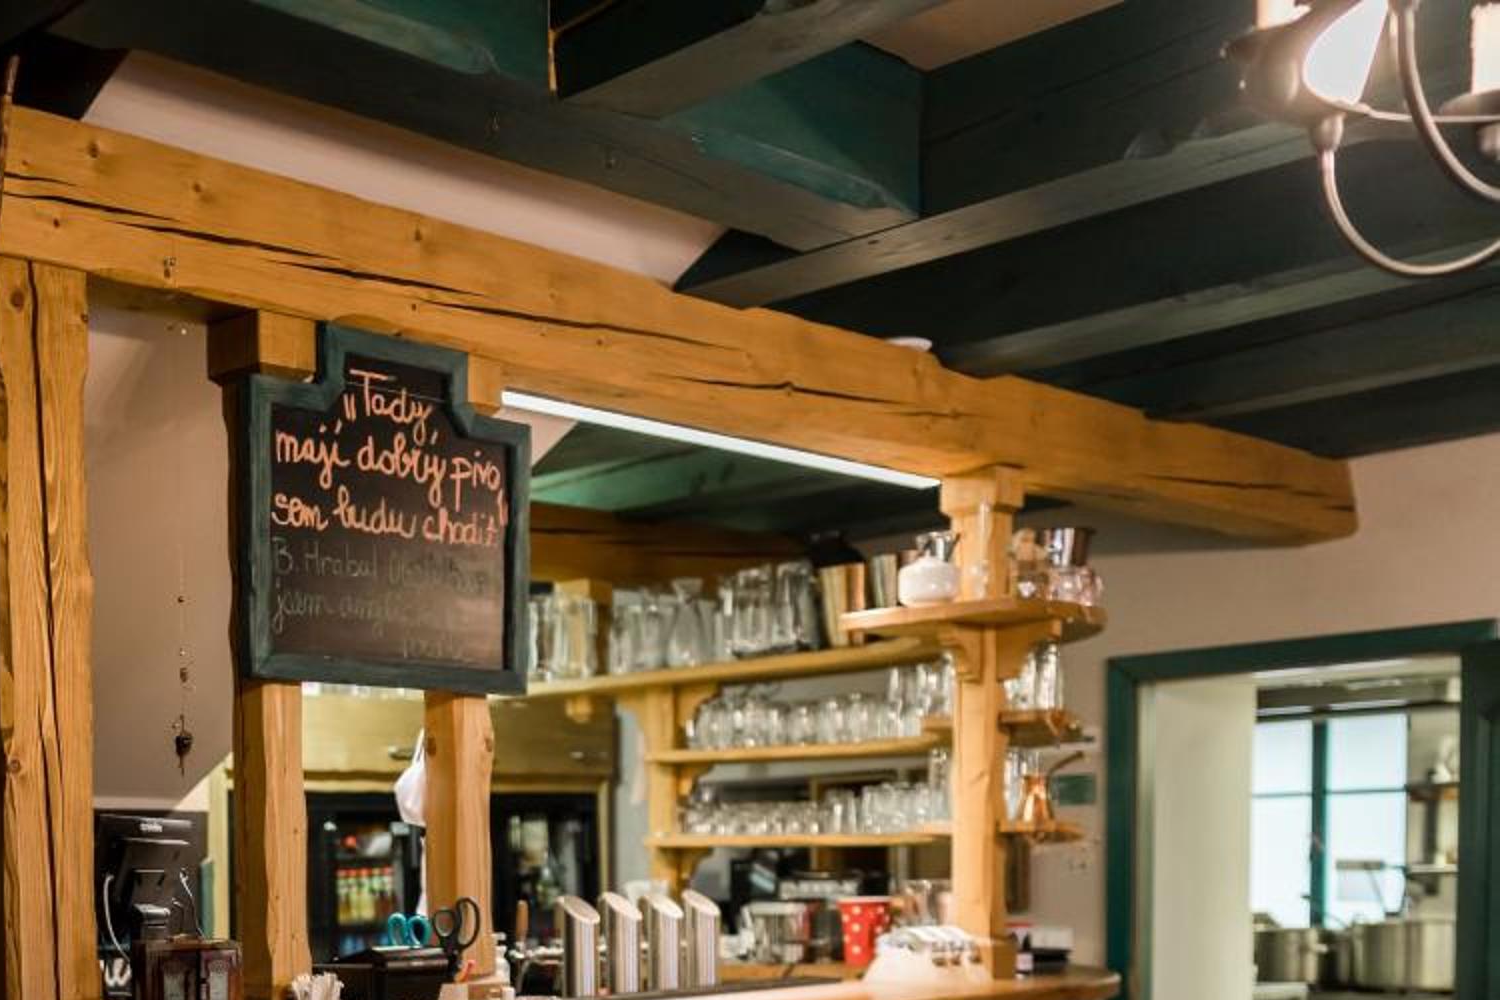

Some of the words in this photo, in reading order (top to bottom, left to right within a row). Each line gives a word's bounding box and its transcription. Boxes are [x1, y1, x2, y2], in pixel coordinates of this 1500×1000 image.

[275, 419, 351, 489] mají
[357, 430, 447, 509] dobrý
[271, 492, 329, 530] sem
